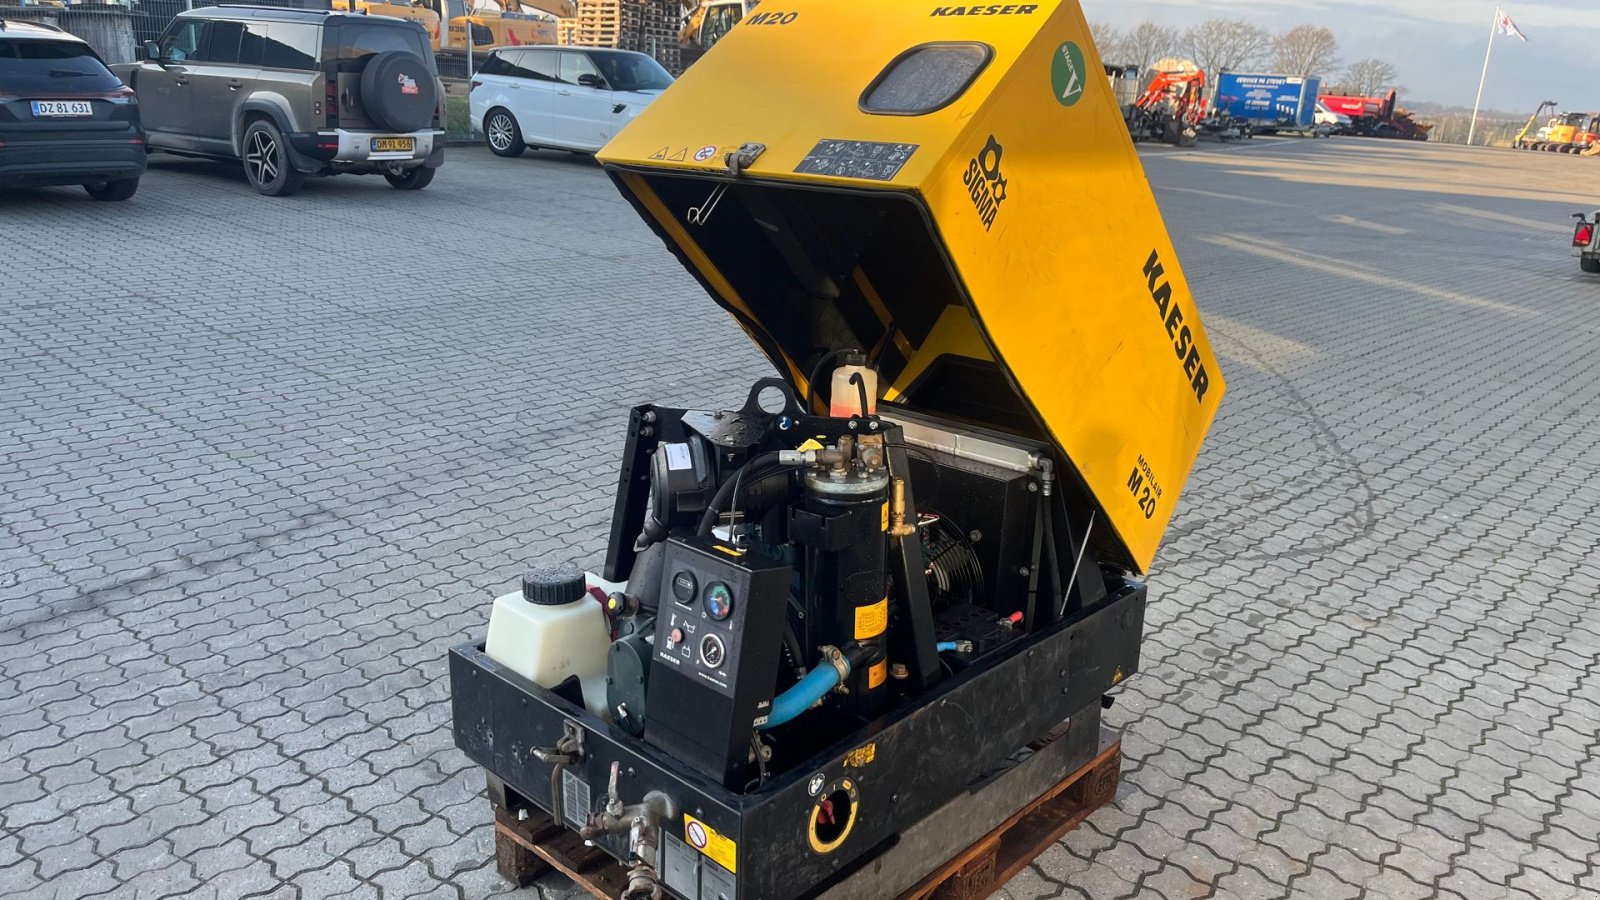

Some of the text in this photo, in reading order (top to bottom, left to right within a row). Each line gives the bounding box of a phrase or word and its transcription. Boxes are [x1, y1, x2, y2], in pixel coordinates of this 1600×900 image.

[744, 11, 799, 26] M20
[930, 4, 1039, 17] KAESER
[1061, 44, 1075, 73] STAGE
[1062, 69, 1082, 99] V
[39, 103, 90, 113] DZ 81 631
[963, 158, 998, 234] SIGMA
[1142, 248, 1210, 405] KAESER
[1137, 454, 1163, 499] MOBILAIR
[1127, 466, 1156, 520] M 20
[660, 651, 680, 665] KAESER
